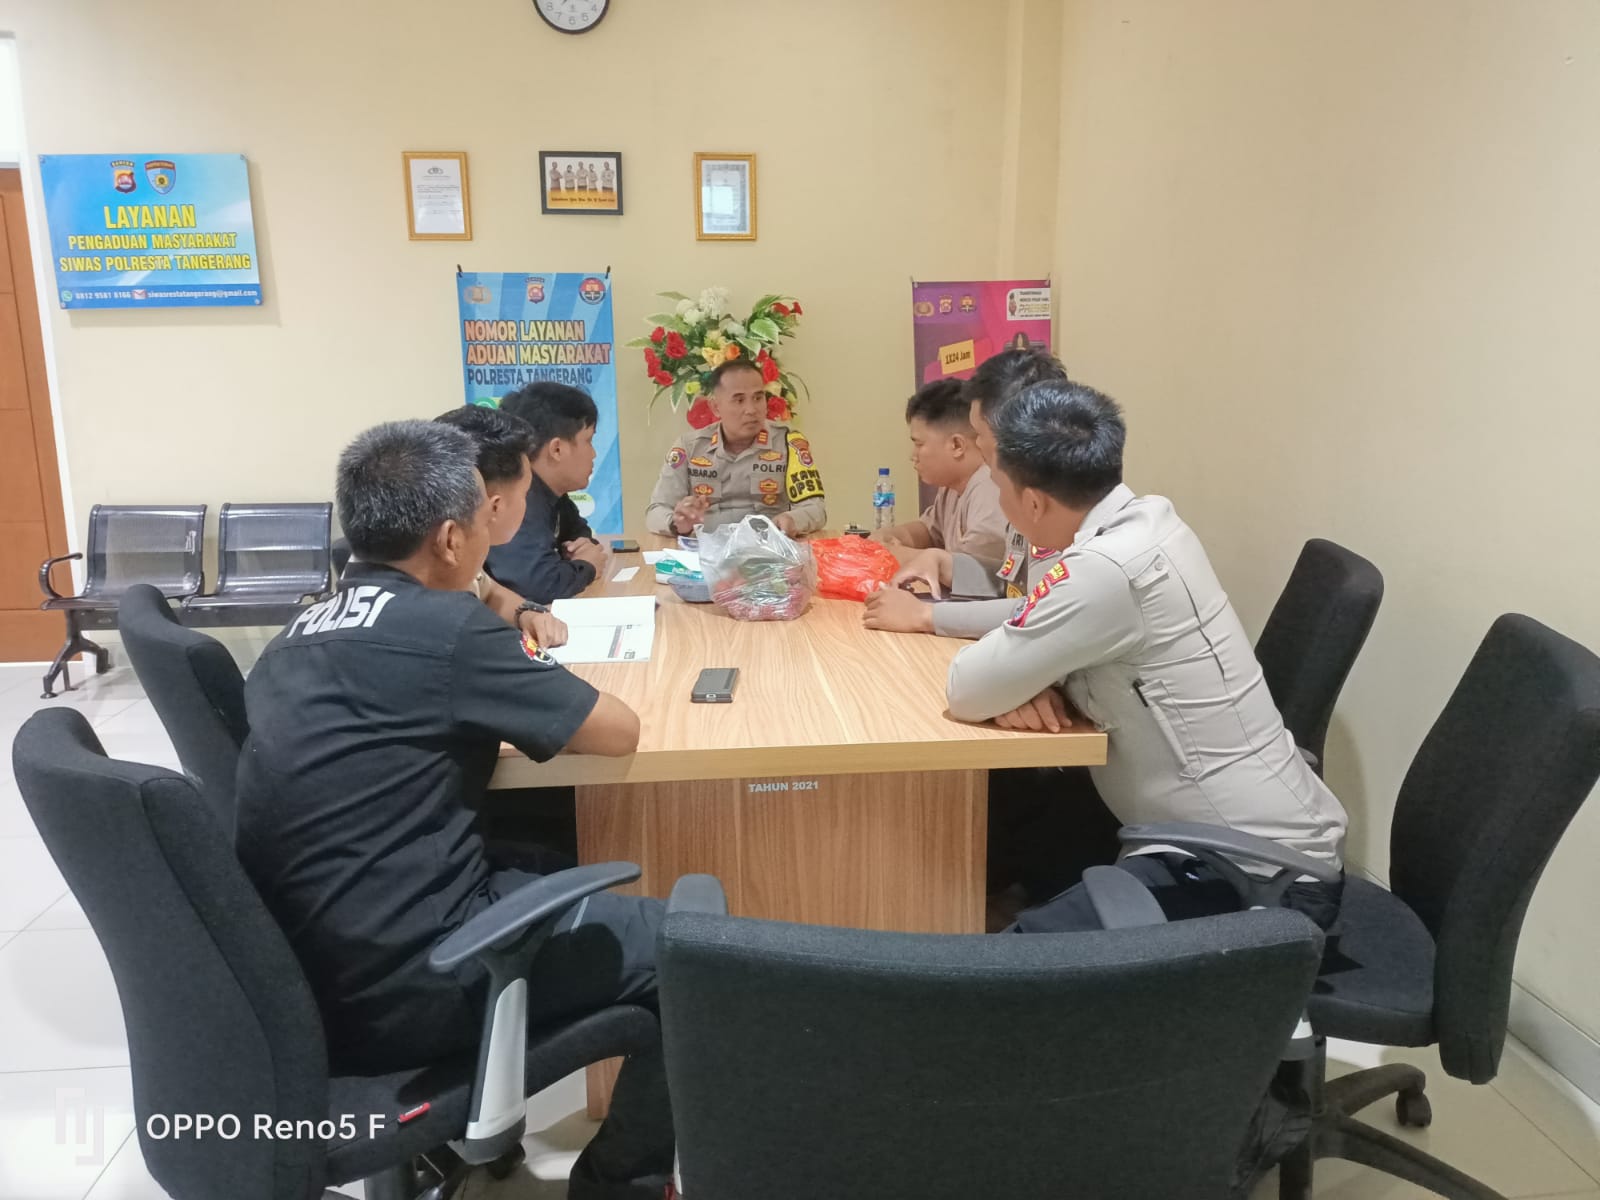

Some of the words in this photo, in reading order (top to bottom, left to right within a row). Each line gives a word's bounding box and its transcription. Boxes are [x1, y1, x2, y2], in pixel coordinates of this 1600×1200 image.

[104, 204, 196, 229] LAYANAN
[68, 234, 148, 250] PENGADUAN
[152, 232, 237, 249] MASYARAKAT
[59, 256, 102, 272] SIWAS
[106, 255, 172, 272] POLRESTA
[176, 254, 251, 270] TANGERANG
[464, 320, 518, 342] NOMOR
[519, 320, 585, 342] LAYANAN
[466, 343, 517, 366] ADUAN
[519, 343, 611, 365] MASYARAKAT
[467, 368, 523, 385] POLRESTA
[527, 367, 593, 385] TANGERANG
[752, 463, 787, 473] POLRI
[286, 585, 396, 639] POLISI
[747, 782, 789, 793] TAHUN
[792, 780, 819, 791] 2021
